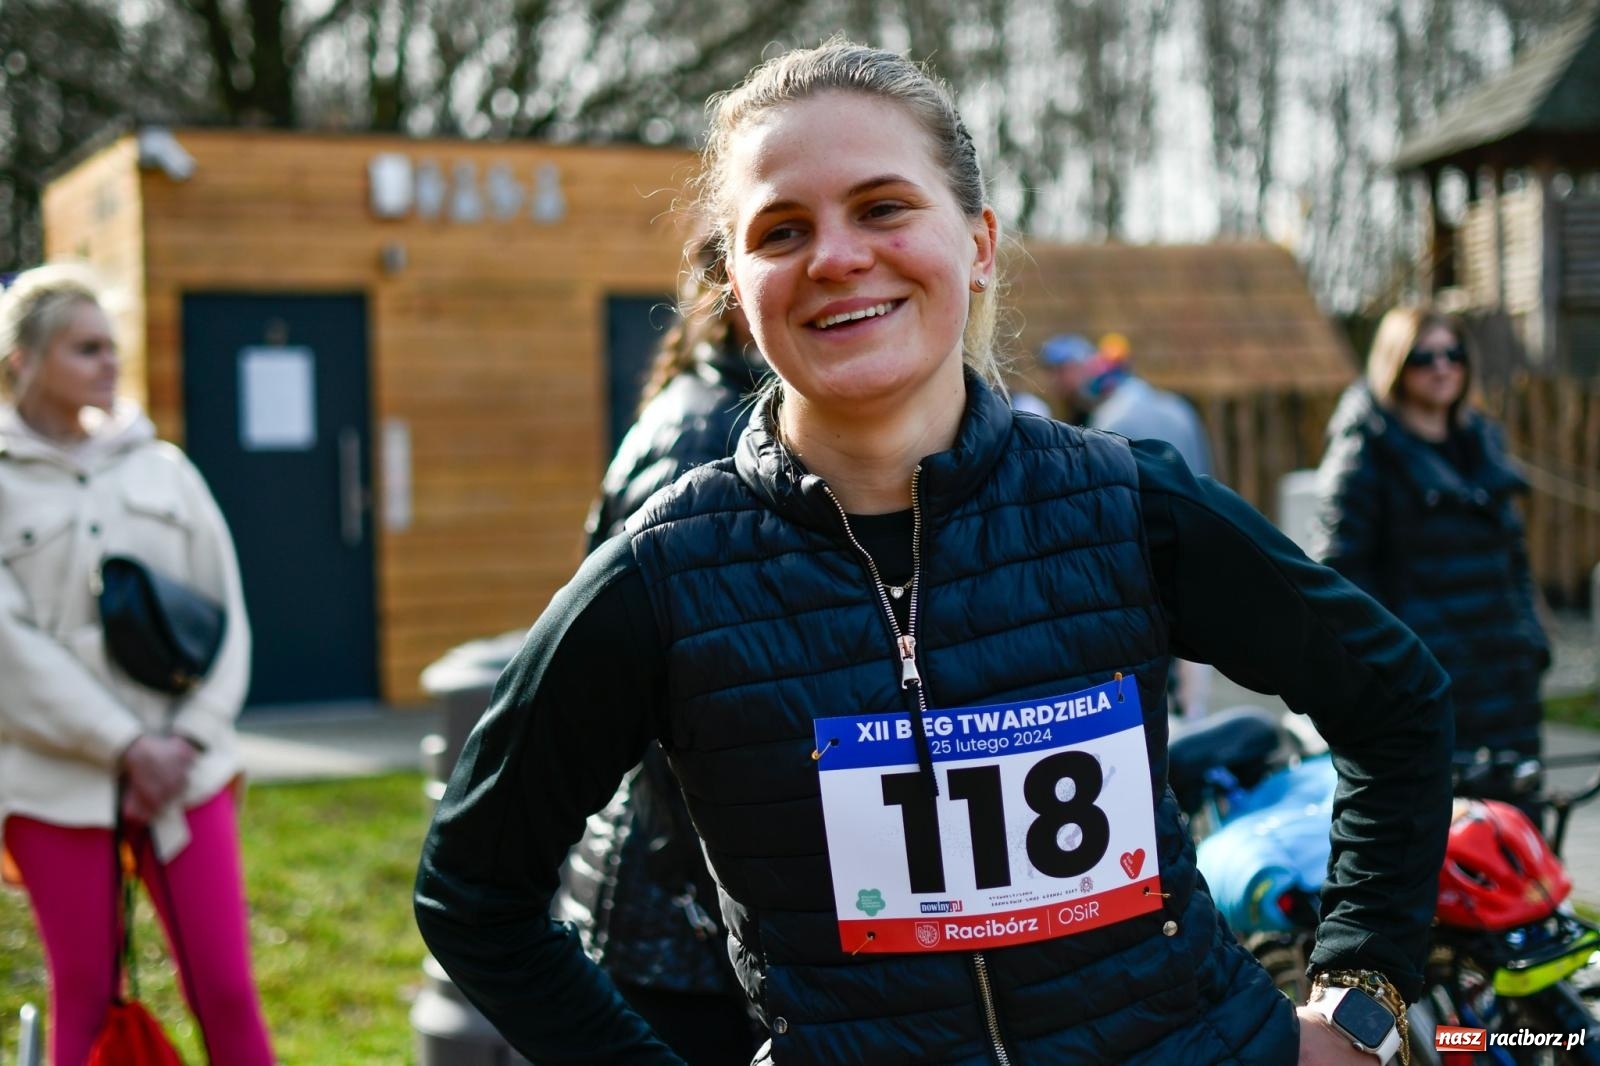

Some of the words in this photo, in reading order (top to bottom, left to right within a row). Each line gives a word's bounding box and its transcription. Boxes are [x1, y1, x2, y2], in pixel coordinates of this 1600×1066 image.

[856, 720, 890, 742] XII
[895, 716, 953, 739] BEG
[957, 691, 1112, 735] TWARDZIELA
[931, 740, 952, 755] 25
[956, 736, 1010, 754] lutego
[1013, 728, 1053, 747] 2024
[881, 750, 1110, 894] 118
[921, 900, 962, 913] nowiny.pl
[945, 915, 1039, 940] Racibórz
[1058, 901, 1100, 925] OSiR
